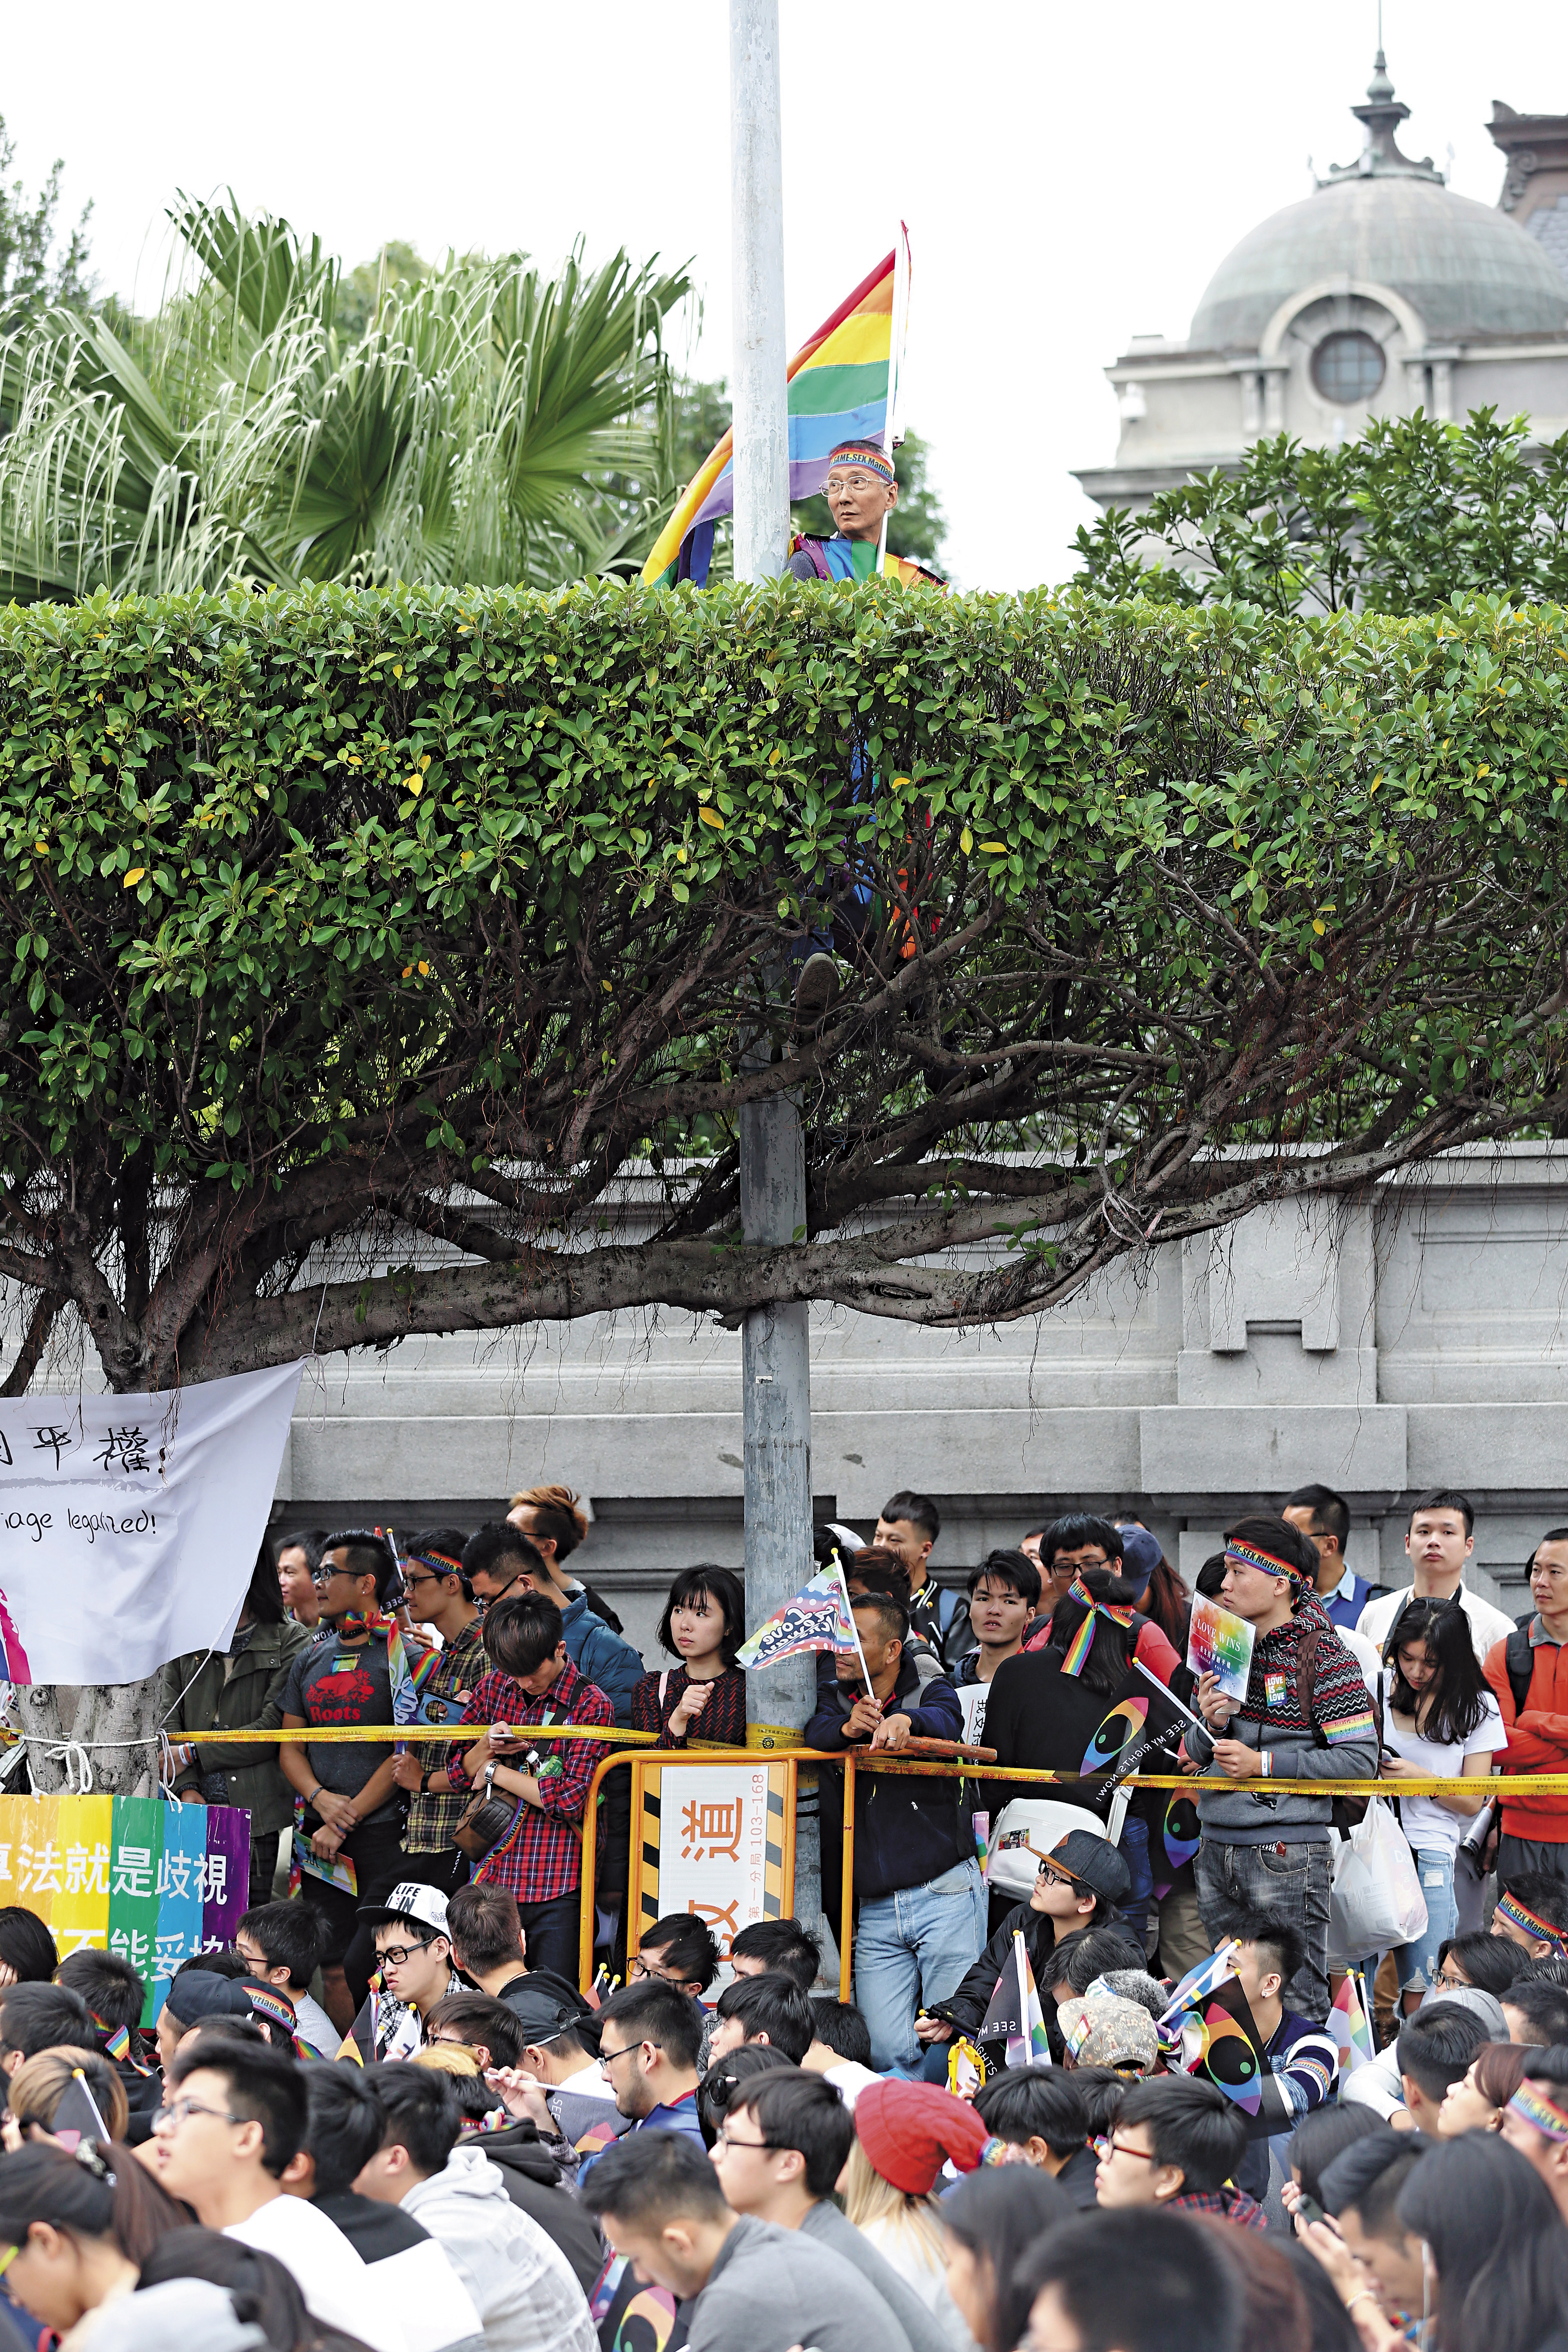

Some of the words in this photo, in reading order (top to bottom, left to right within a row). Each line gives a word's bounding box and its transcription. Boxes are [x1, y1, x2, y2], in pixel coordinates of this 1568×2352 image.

[833, 453, 867, 465] SAME-SEX
[868, 457, 893, 479] Marriage
[0, 1512, 53, 1542] iage
[68, 1508, 156, 1544] legalized!
[420, 1551, 454, 1572] Marriage
[1230, 1542, 1256, 1561] AME-SEX
[1255, 1555, 1290, 1577] Marriage
[1197, 1618, 1216, 1639] LOVE
[1219, 1631, 1241, 1652] WINS
[1267, 1676, 1283, 1686] LOVE
[1268, 1685, 1275, 1694] IS
[1269, 1692, 1285, 1702] LOVE
[310, 1705, 361, 1722] Roots
[395, 1885, 421, 1897] LIFE
[1525, 1918, 1558, 1942] Marriage
[249, 1994, 279, 2012] arriage
[975, 2042, 998, 2076] IGHTS
[1102, 2047, 1129, 2061] UNDER
[551, 2098, 563, 2121] SEE
